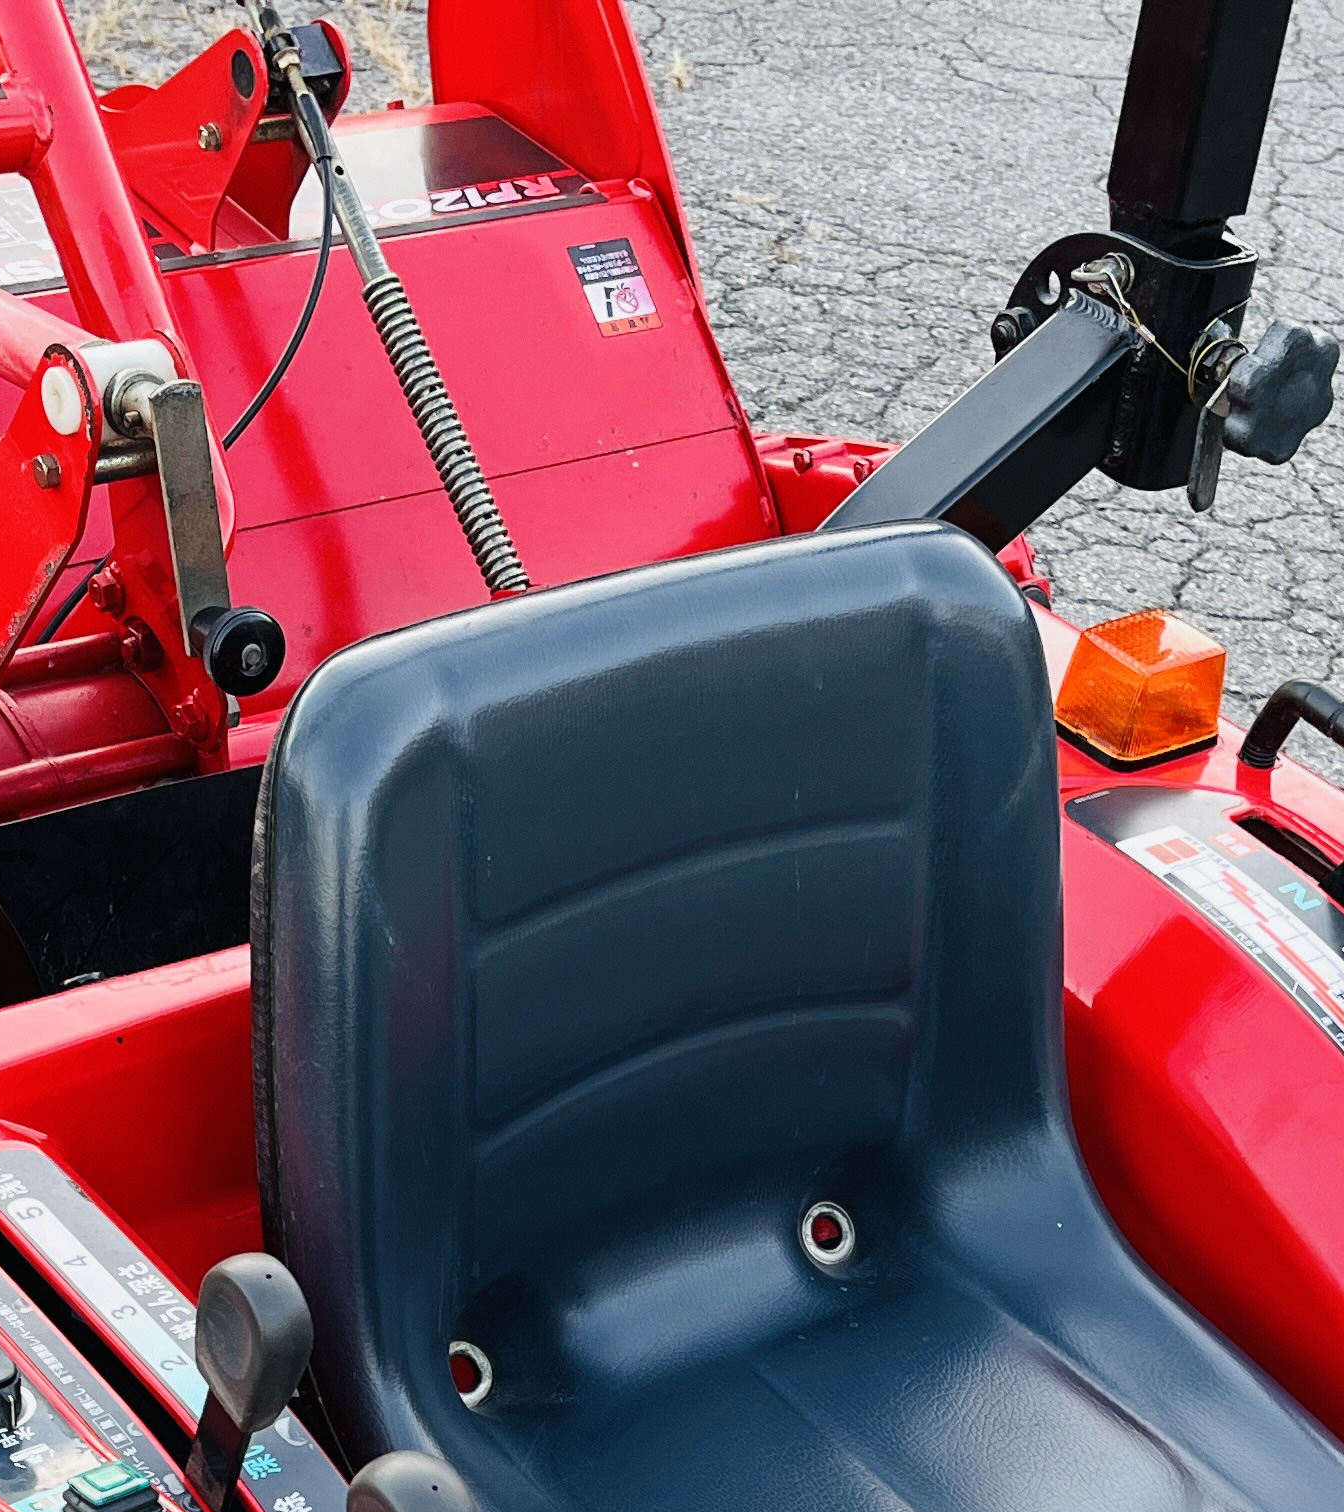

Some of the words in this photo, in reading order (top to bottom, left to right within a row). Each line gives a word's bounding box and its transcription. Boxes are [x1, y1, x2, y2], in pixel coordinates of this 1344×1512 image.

[1278, 881, 1322, 912] N
[15, 1205, 44, 1220] 5
[63, 1254, 88, 1268] 4
[111, 1304, 138, 1320] 3
[160, 1354, 189, 1372] 2
